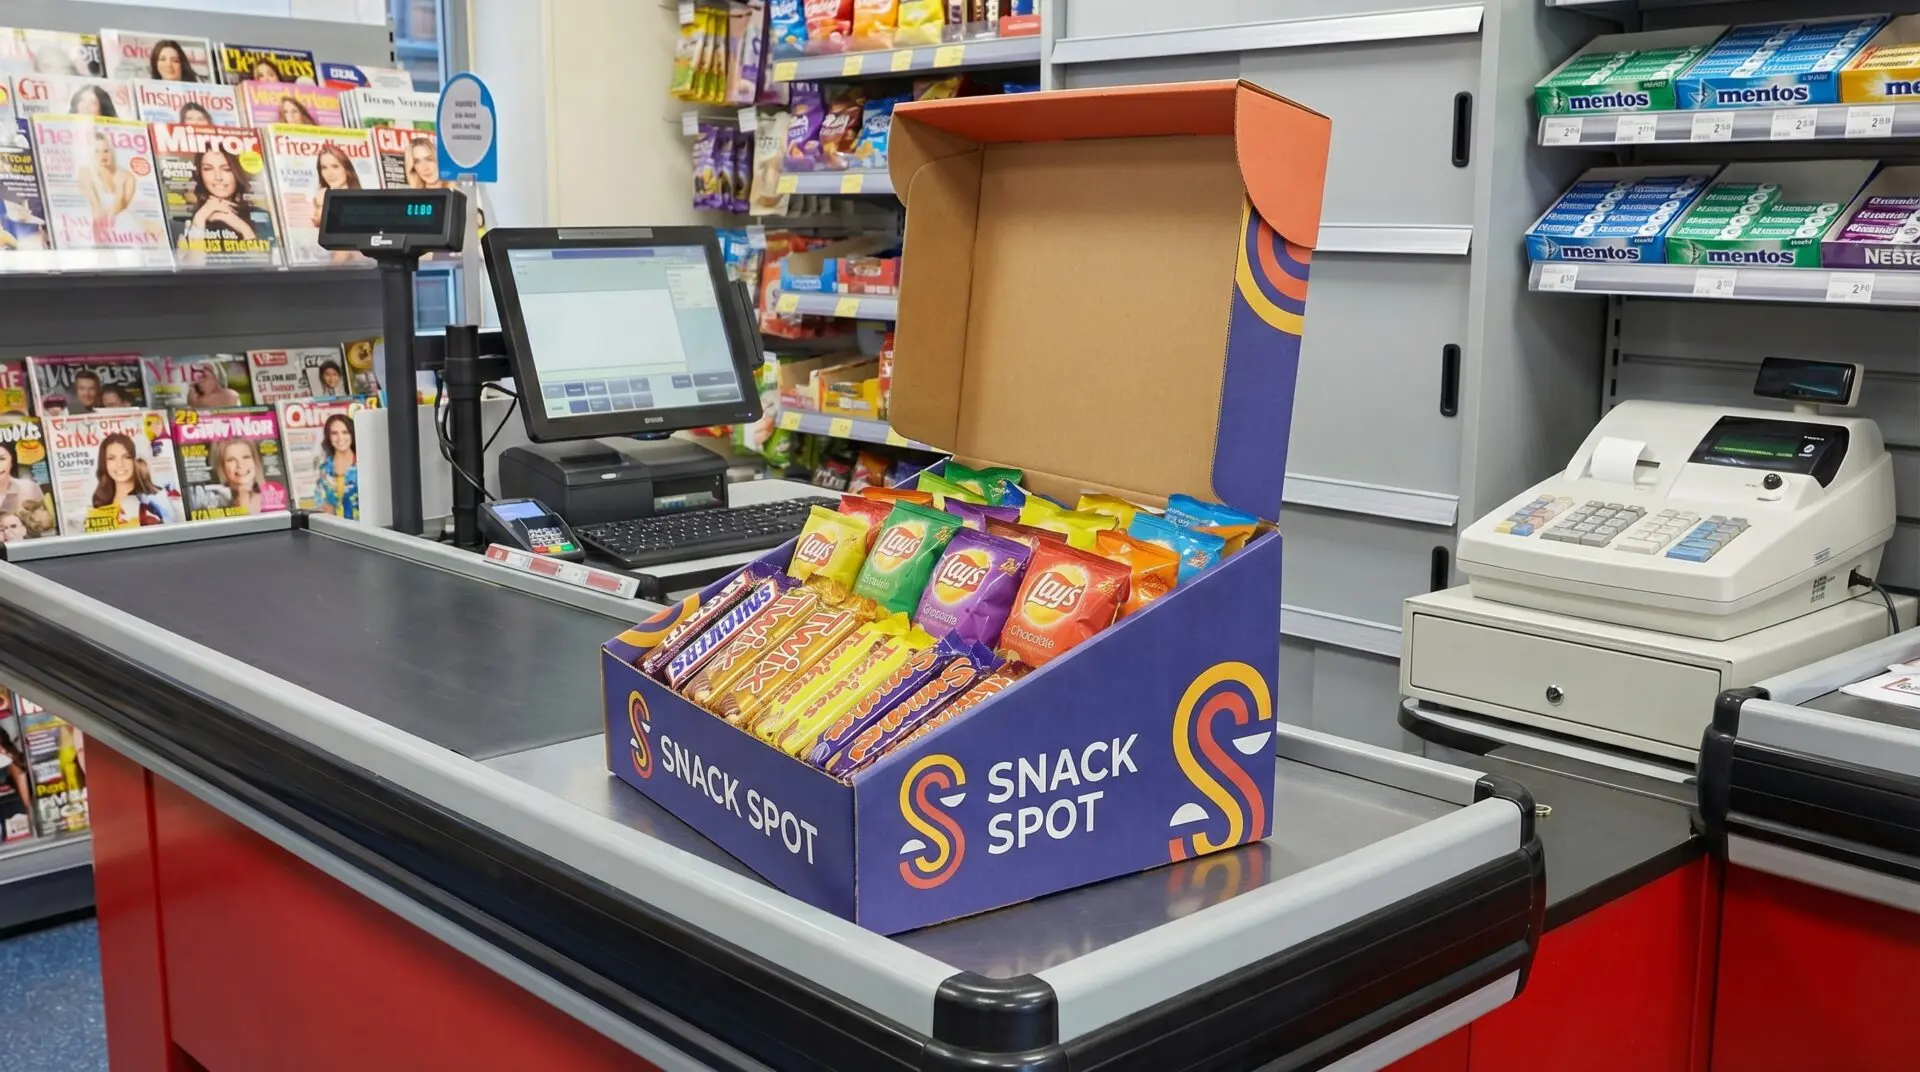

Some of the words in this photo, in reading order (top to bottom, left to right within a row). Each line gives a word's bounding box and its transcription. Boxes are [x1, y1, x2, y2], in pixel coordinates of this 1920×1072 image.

[1569, 91, 1650, 111] mentos
[1717, 84, 1810, 104] mentos
[153, 123, 259, 156] Mirror
[1562, 246, 1639, 260] mentos
[1709, 250, 1795, 265] mentos
[1027, 572, 1082, 609] Lay's
[709, 593, 818, 671] Twix
[736, 608, 852, 694] Twix
[988, 733, 1140, 804] SNACK
[661, 735, 743, 819] SNACK
[746, 788, 818, 865] SPOT
[988, 790, 1104, 855] SPOT
